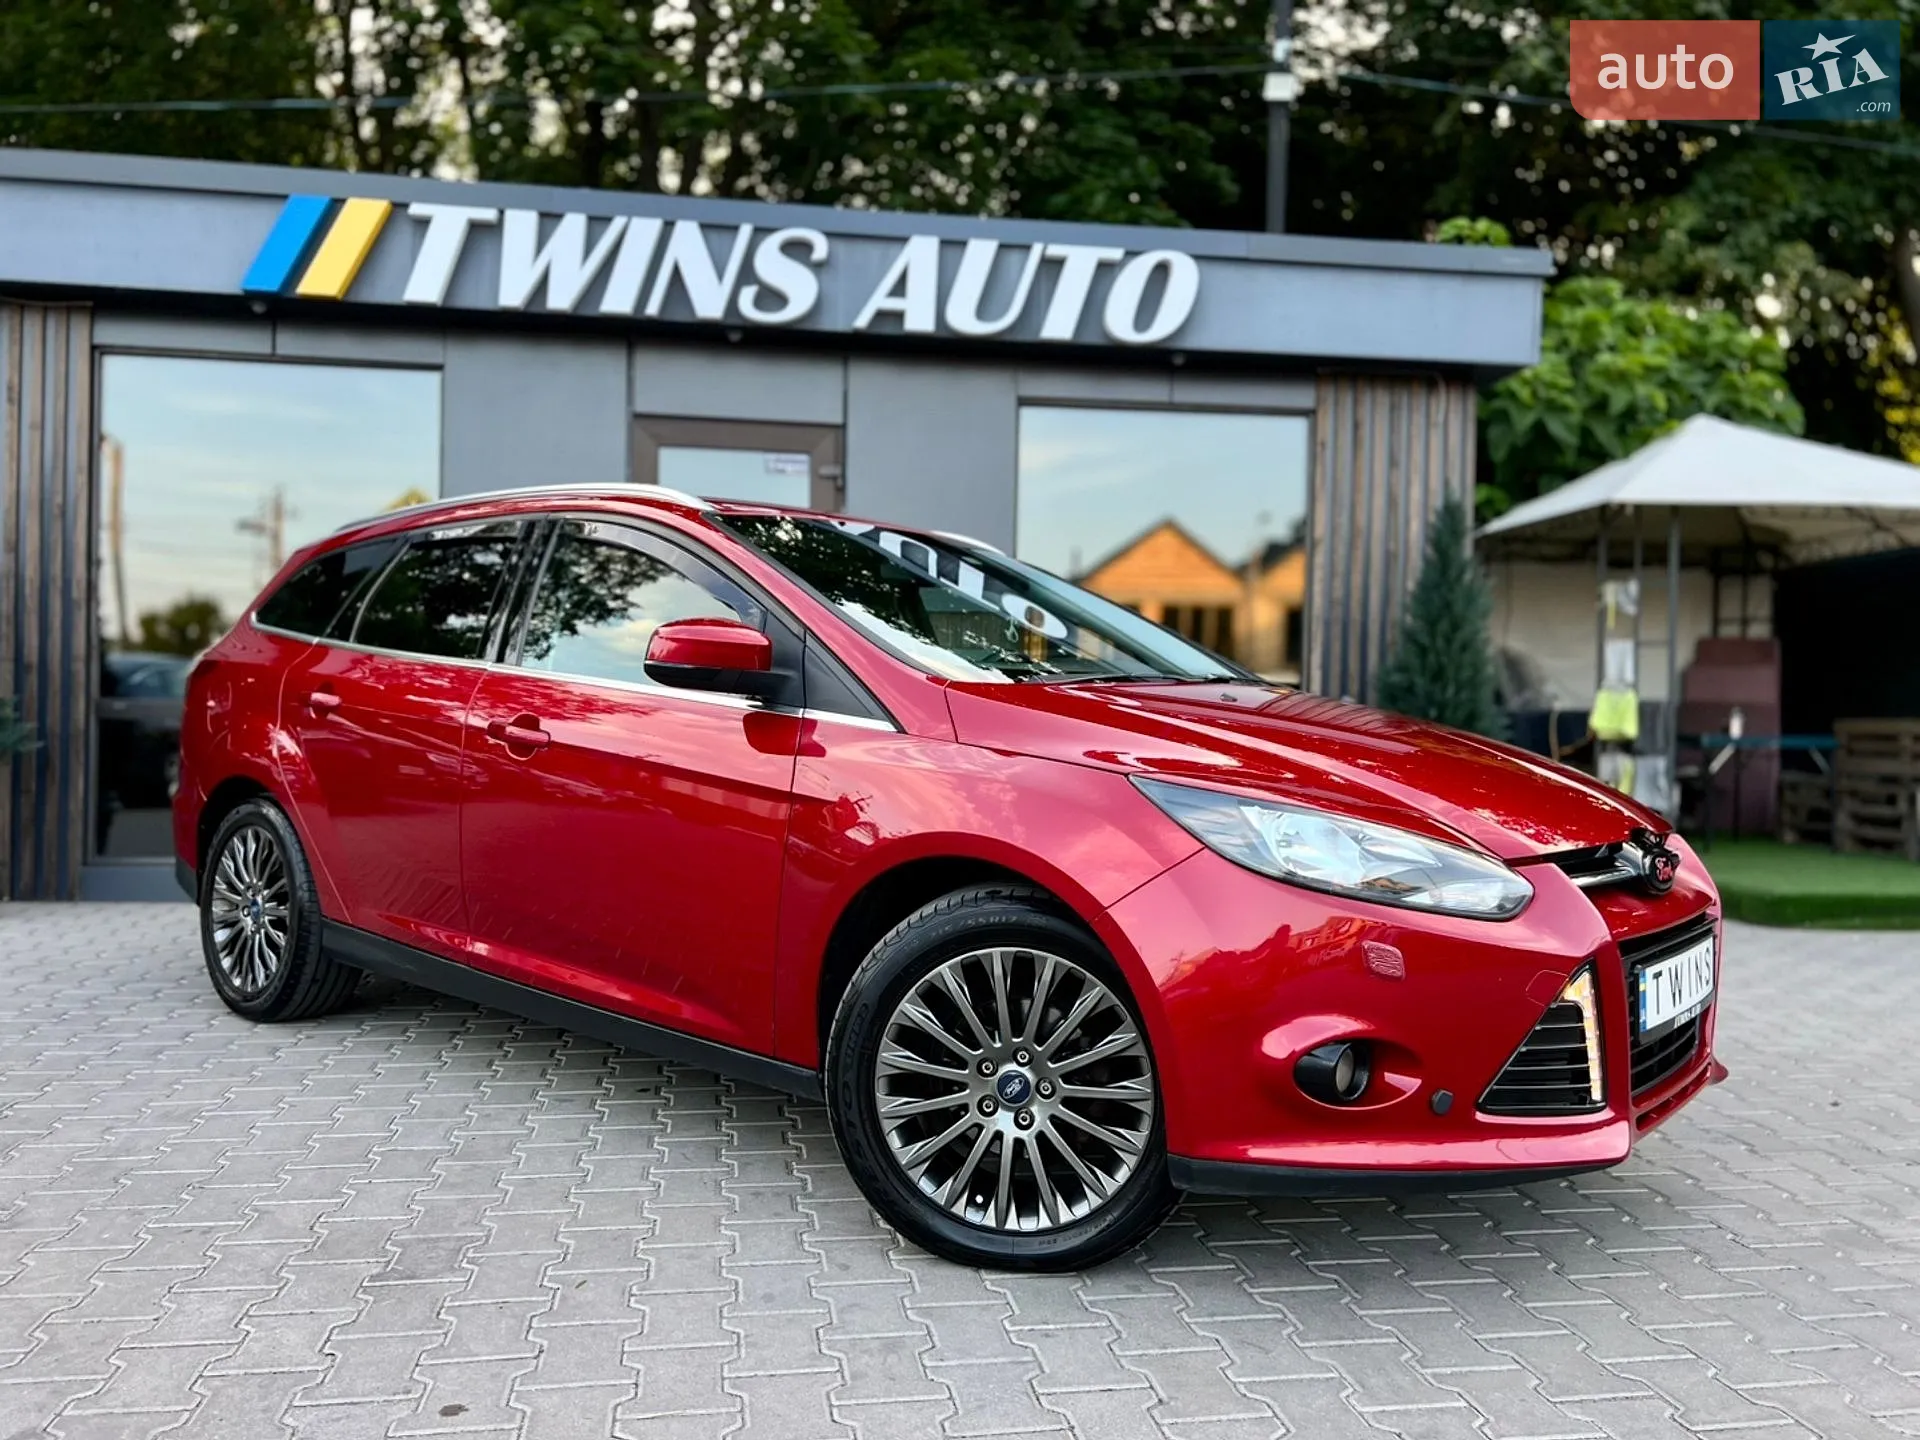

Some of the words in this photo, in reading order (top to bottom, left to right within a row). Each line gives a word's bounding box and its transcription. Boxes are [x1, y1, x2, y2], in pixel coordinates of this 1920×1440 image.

[402, 202, 829, 324] TWINS
[852, 234, 1200, 344] AUTO
[1652, 946, 1711, 1015] TWINS
